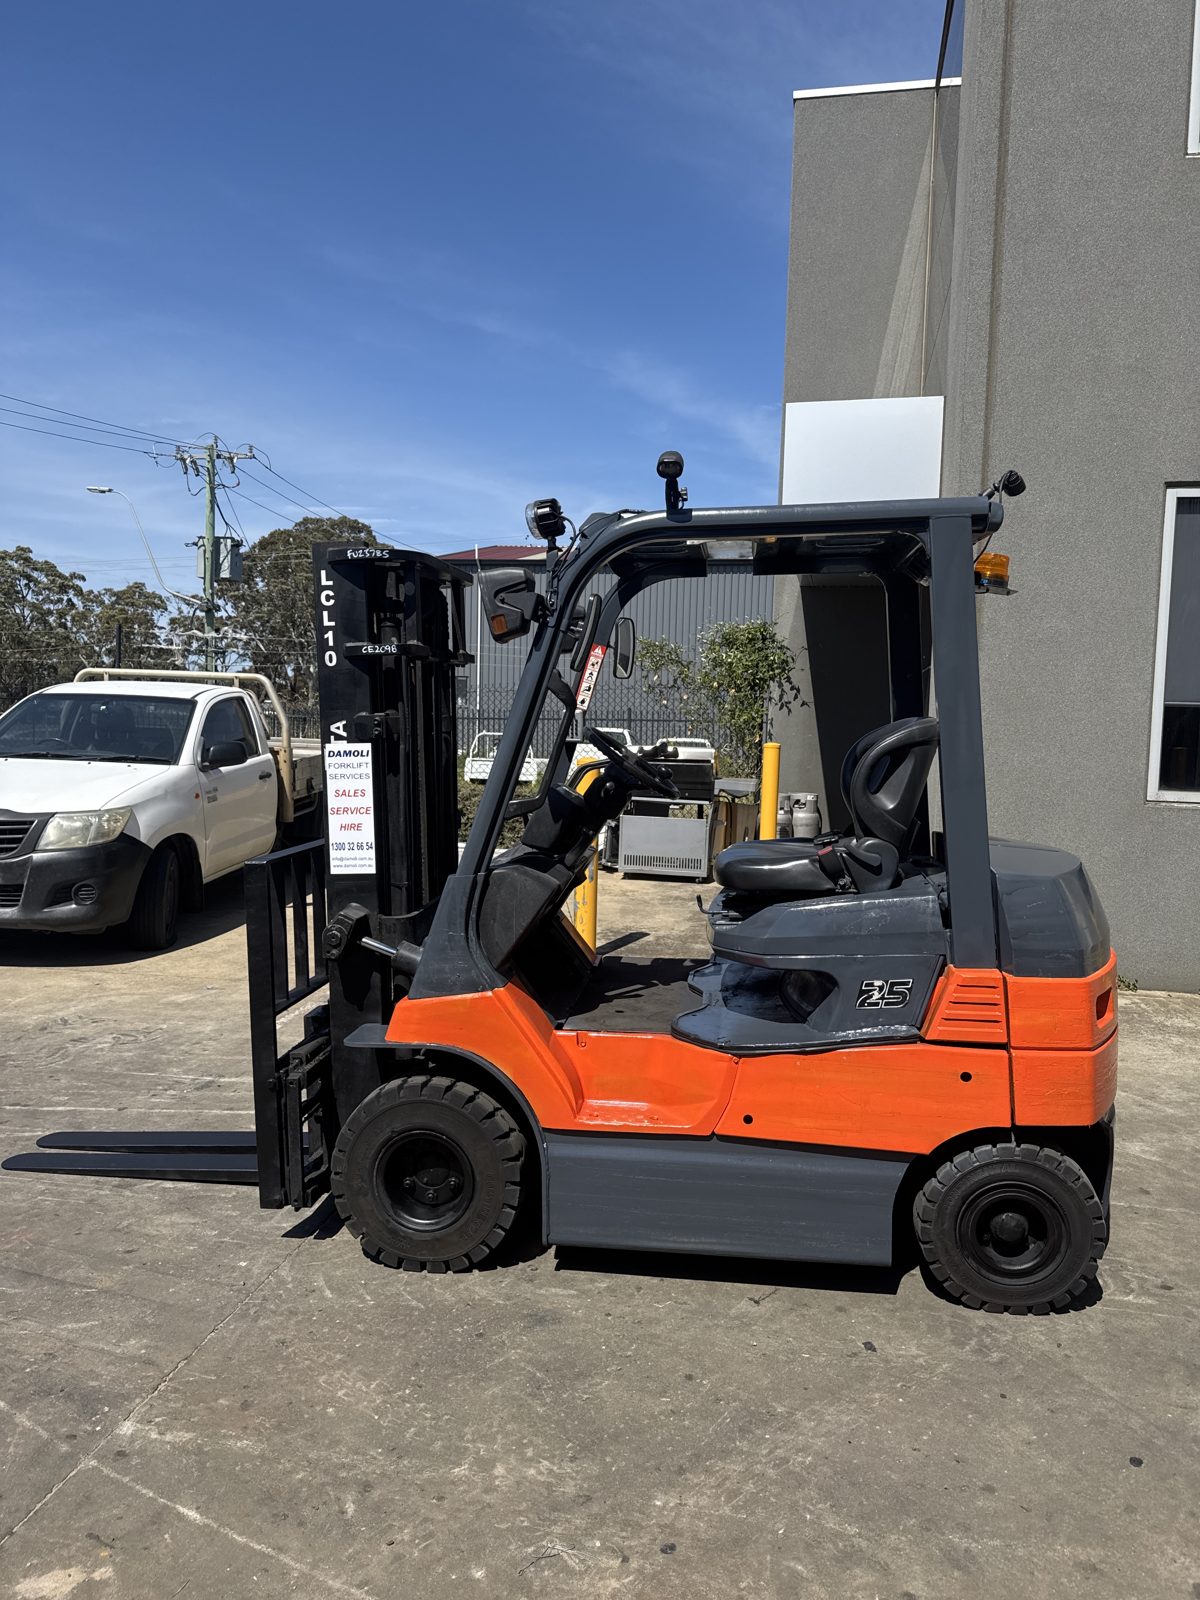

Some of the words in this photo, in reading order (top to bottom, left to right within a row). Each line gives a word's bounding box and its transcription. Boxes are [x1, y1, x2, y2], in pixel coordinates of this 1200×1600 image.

[361, 645, 398, 653] CE2098
[327, 750, 370, 758] DAMOLI
[334, 789, 366, 798] SALES
[329, 806, 372, 815] SERVICE
[339, 823, 363, 831] HIRE
[331, 842, 346, 851] 1300
[347, 842, 355, 851] 32
[356, 842, 365, 851] 66
[365, 842, 374, 851] 54
[855, 979, 913, 1009] 25
